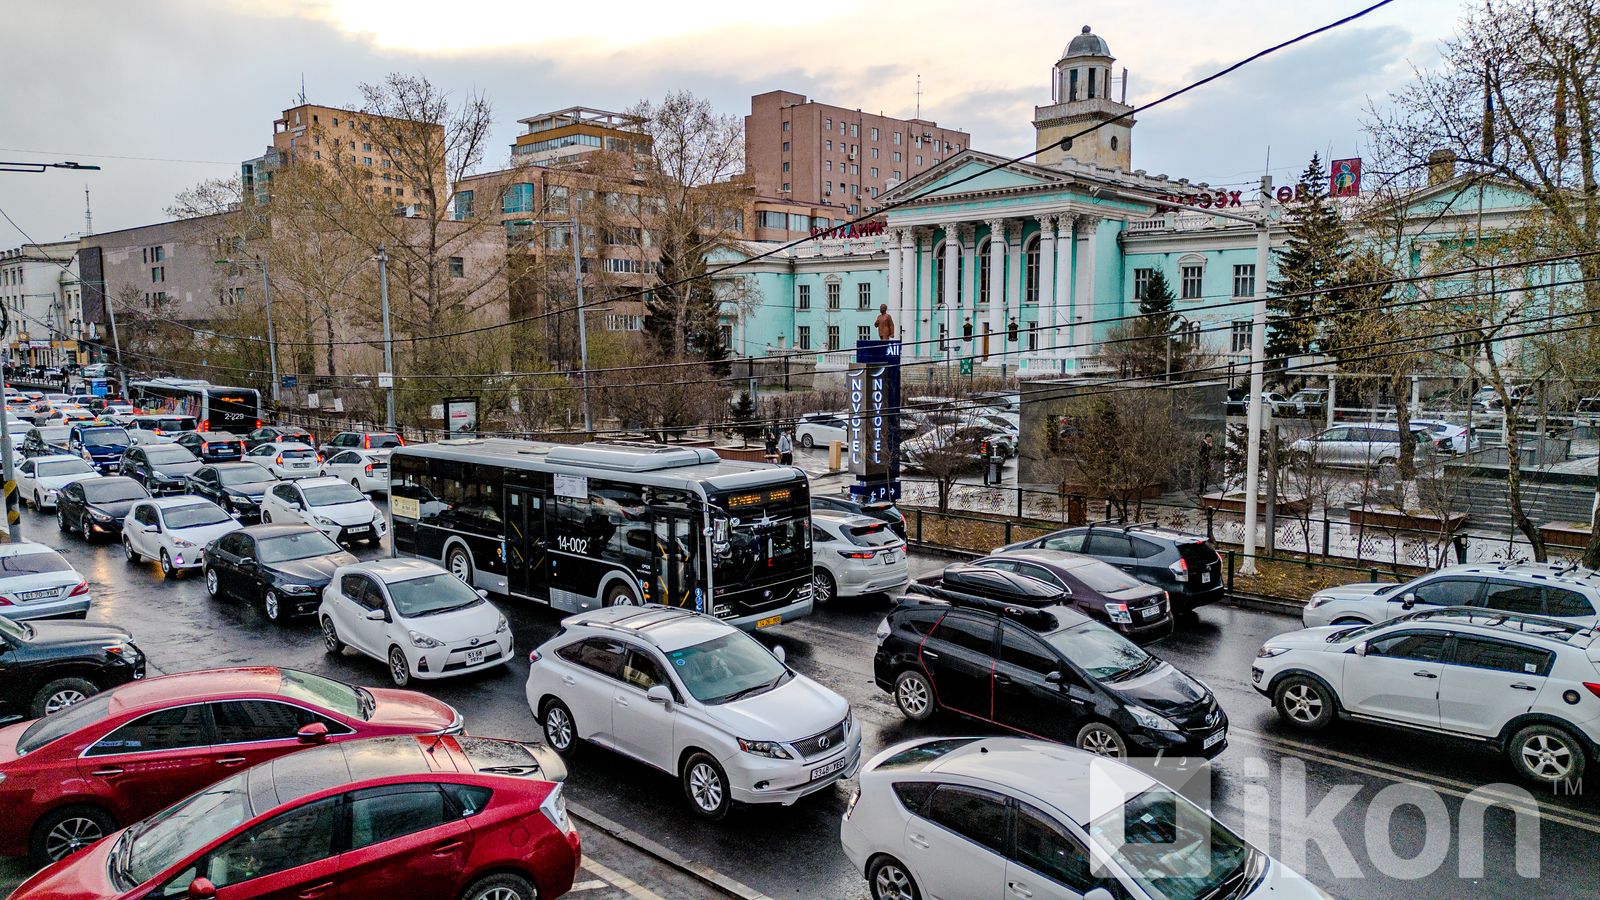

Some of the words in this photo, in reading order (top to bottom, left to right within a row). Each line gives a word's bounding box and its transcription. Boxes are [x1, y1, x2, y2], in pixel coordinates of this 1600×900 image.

[851, 378, 861, 465] NOVOTEL
[874, 378, 883, 464] NOVOTEL
[557, 534, 588, 555] 14-002
